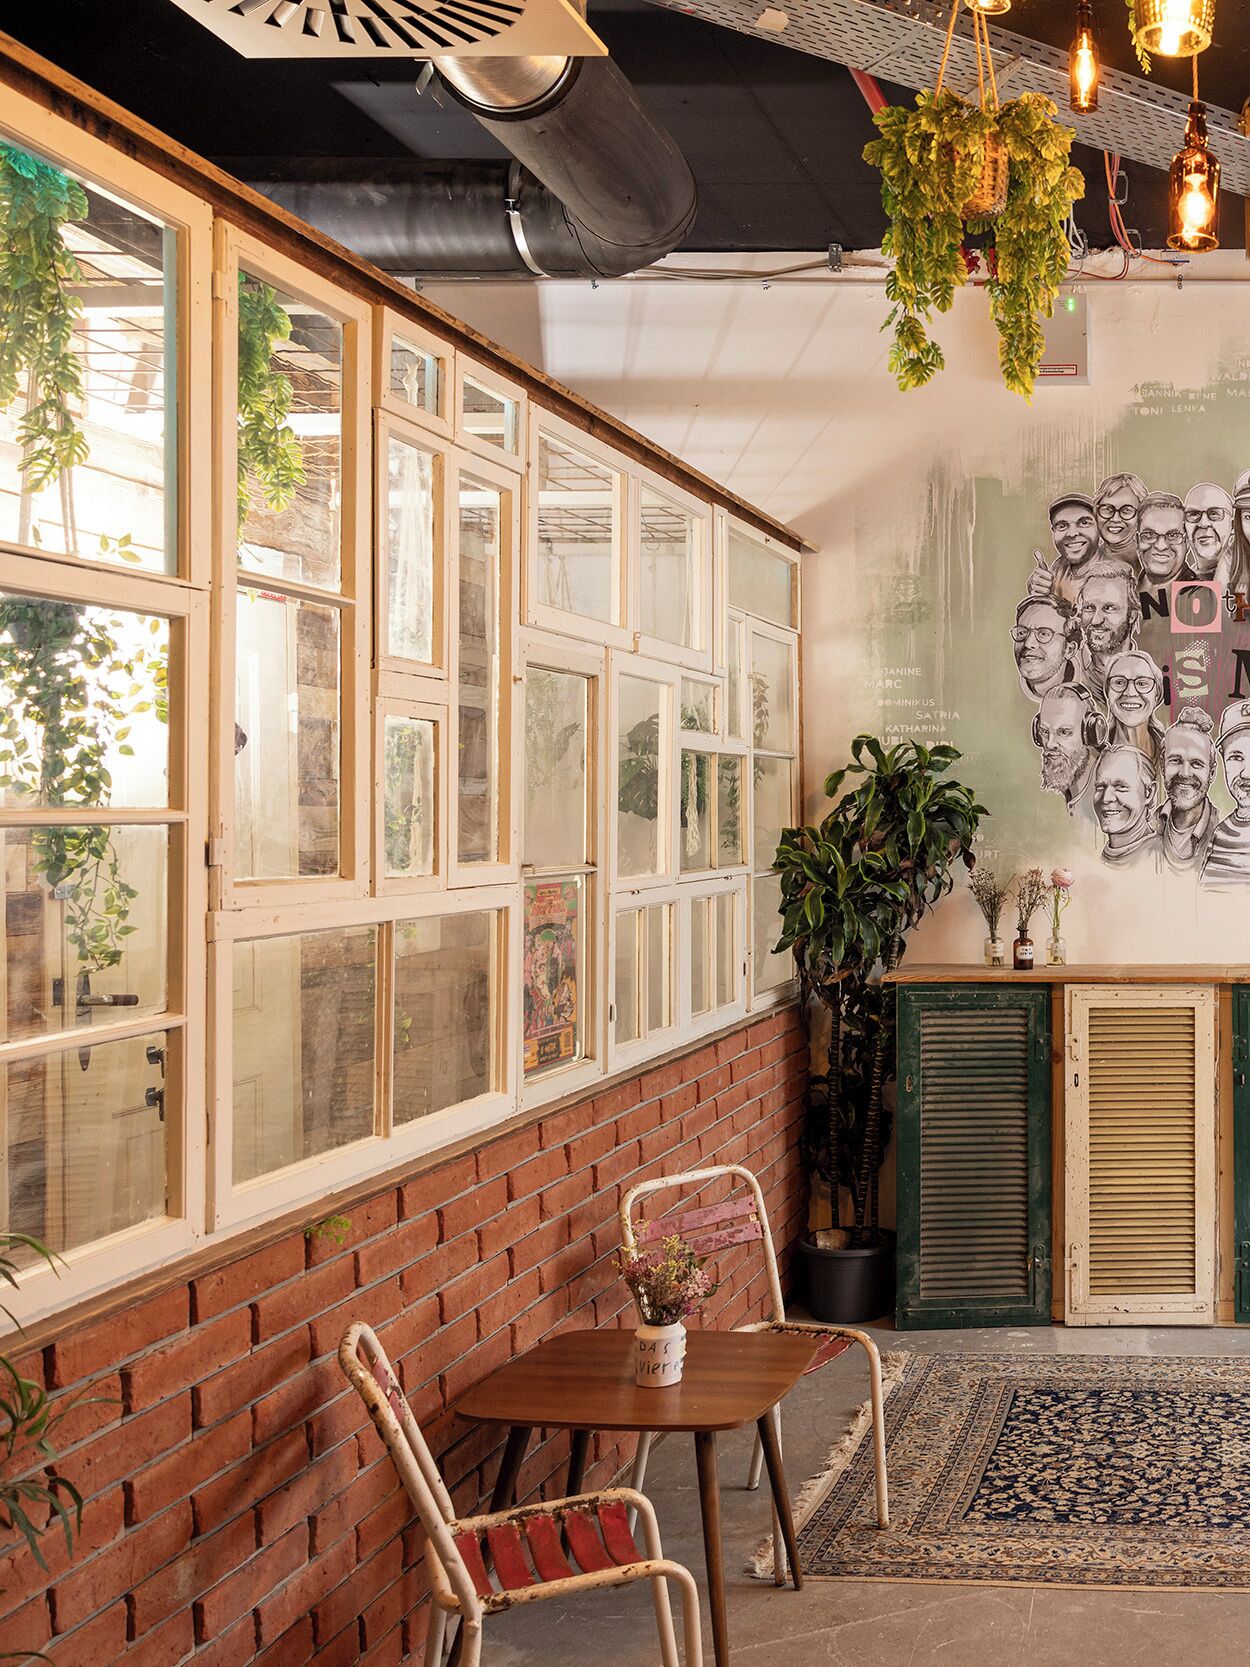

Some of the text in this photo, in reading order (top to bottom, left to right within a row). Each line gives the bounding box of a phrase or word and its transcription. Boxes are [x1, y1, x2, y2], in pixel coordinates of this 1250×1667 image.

[1134, 406, 1164, 417] TONI
[881, 667, 923, 676] JANINE
[864, 679, 903, 689] MARC
[885, 724, 946, 734] KATHARINA
